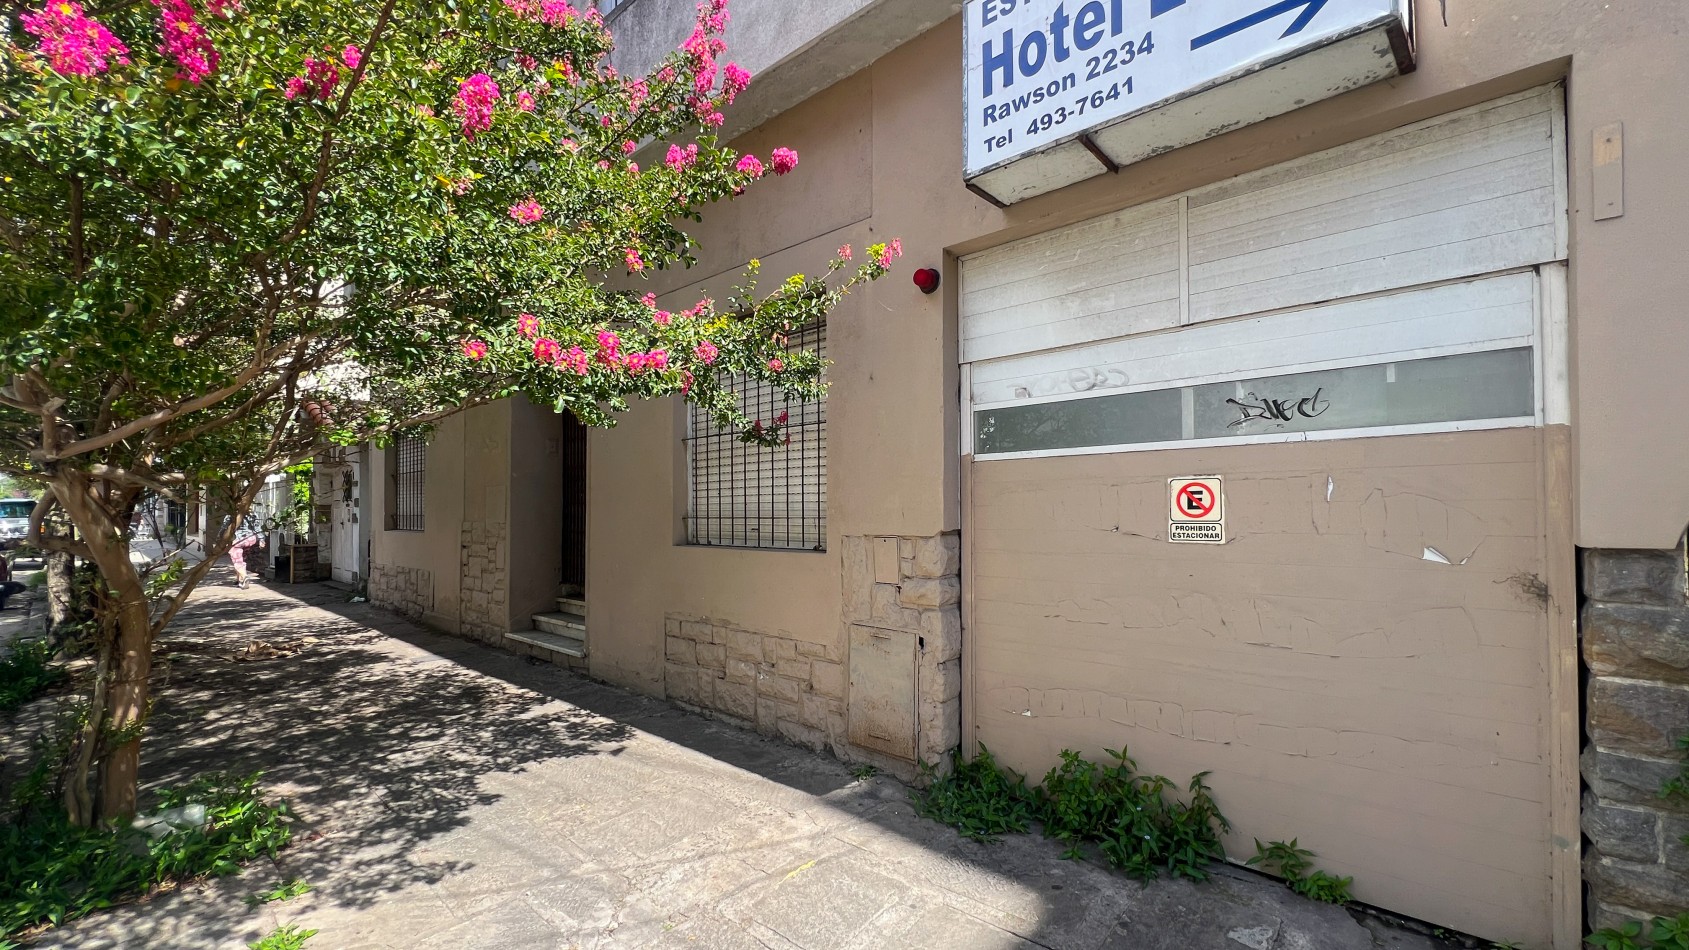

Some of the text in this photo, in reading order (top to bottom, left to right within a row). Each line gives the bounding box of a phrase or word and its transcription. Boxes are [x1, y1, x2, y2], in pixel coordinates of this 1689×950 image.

[982, 0, 1123, 99] Hotel
[983, 31, 1155, 127] Rawson 2234
[983, 76, 1133, 153] Tel 493-7641
